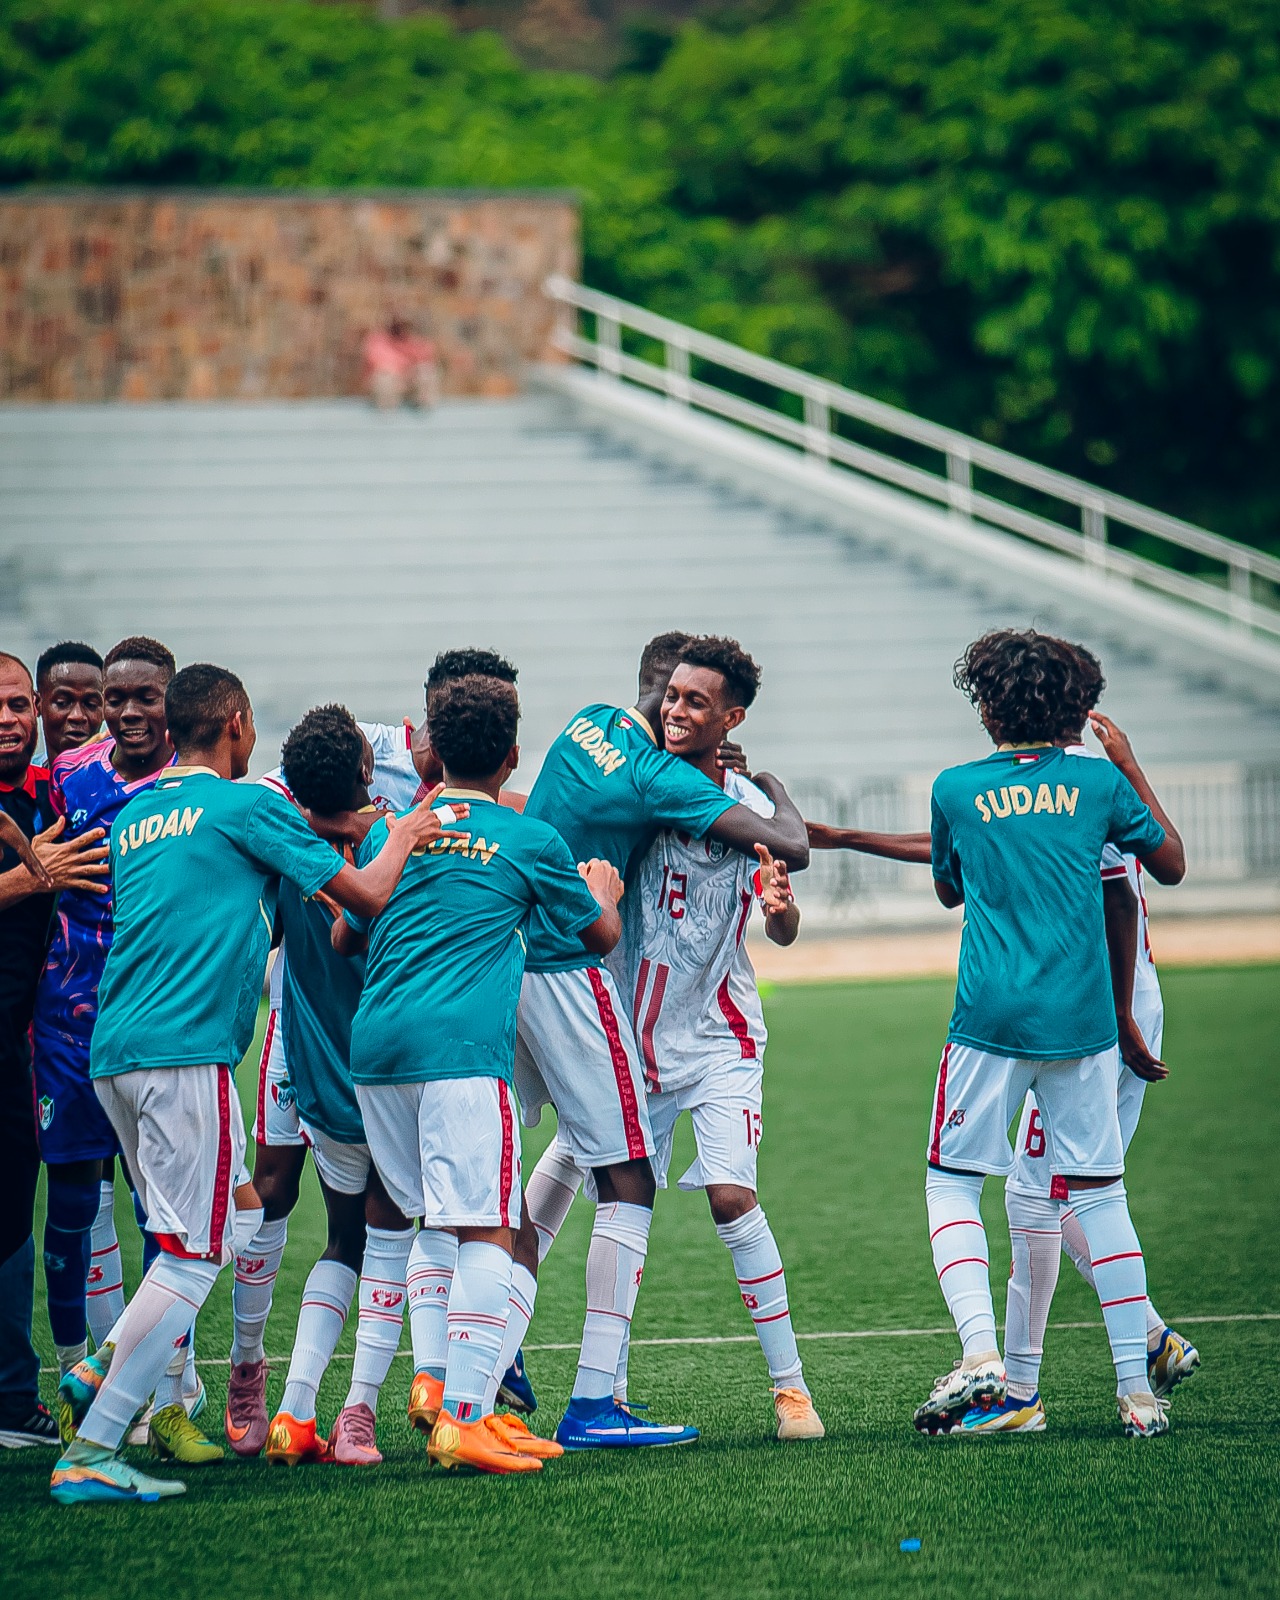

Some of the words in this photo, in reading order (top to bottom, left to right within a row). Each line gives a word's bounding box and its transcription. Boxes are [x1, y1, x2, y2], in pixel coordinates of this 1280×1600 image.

[974, 783, 1079, 823] SUDAN
[119, 806, 204, 856] SUDAN
[657, 864, 688, 919] 12
